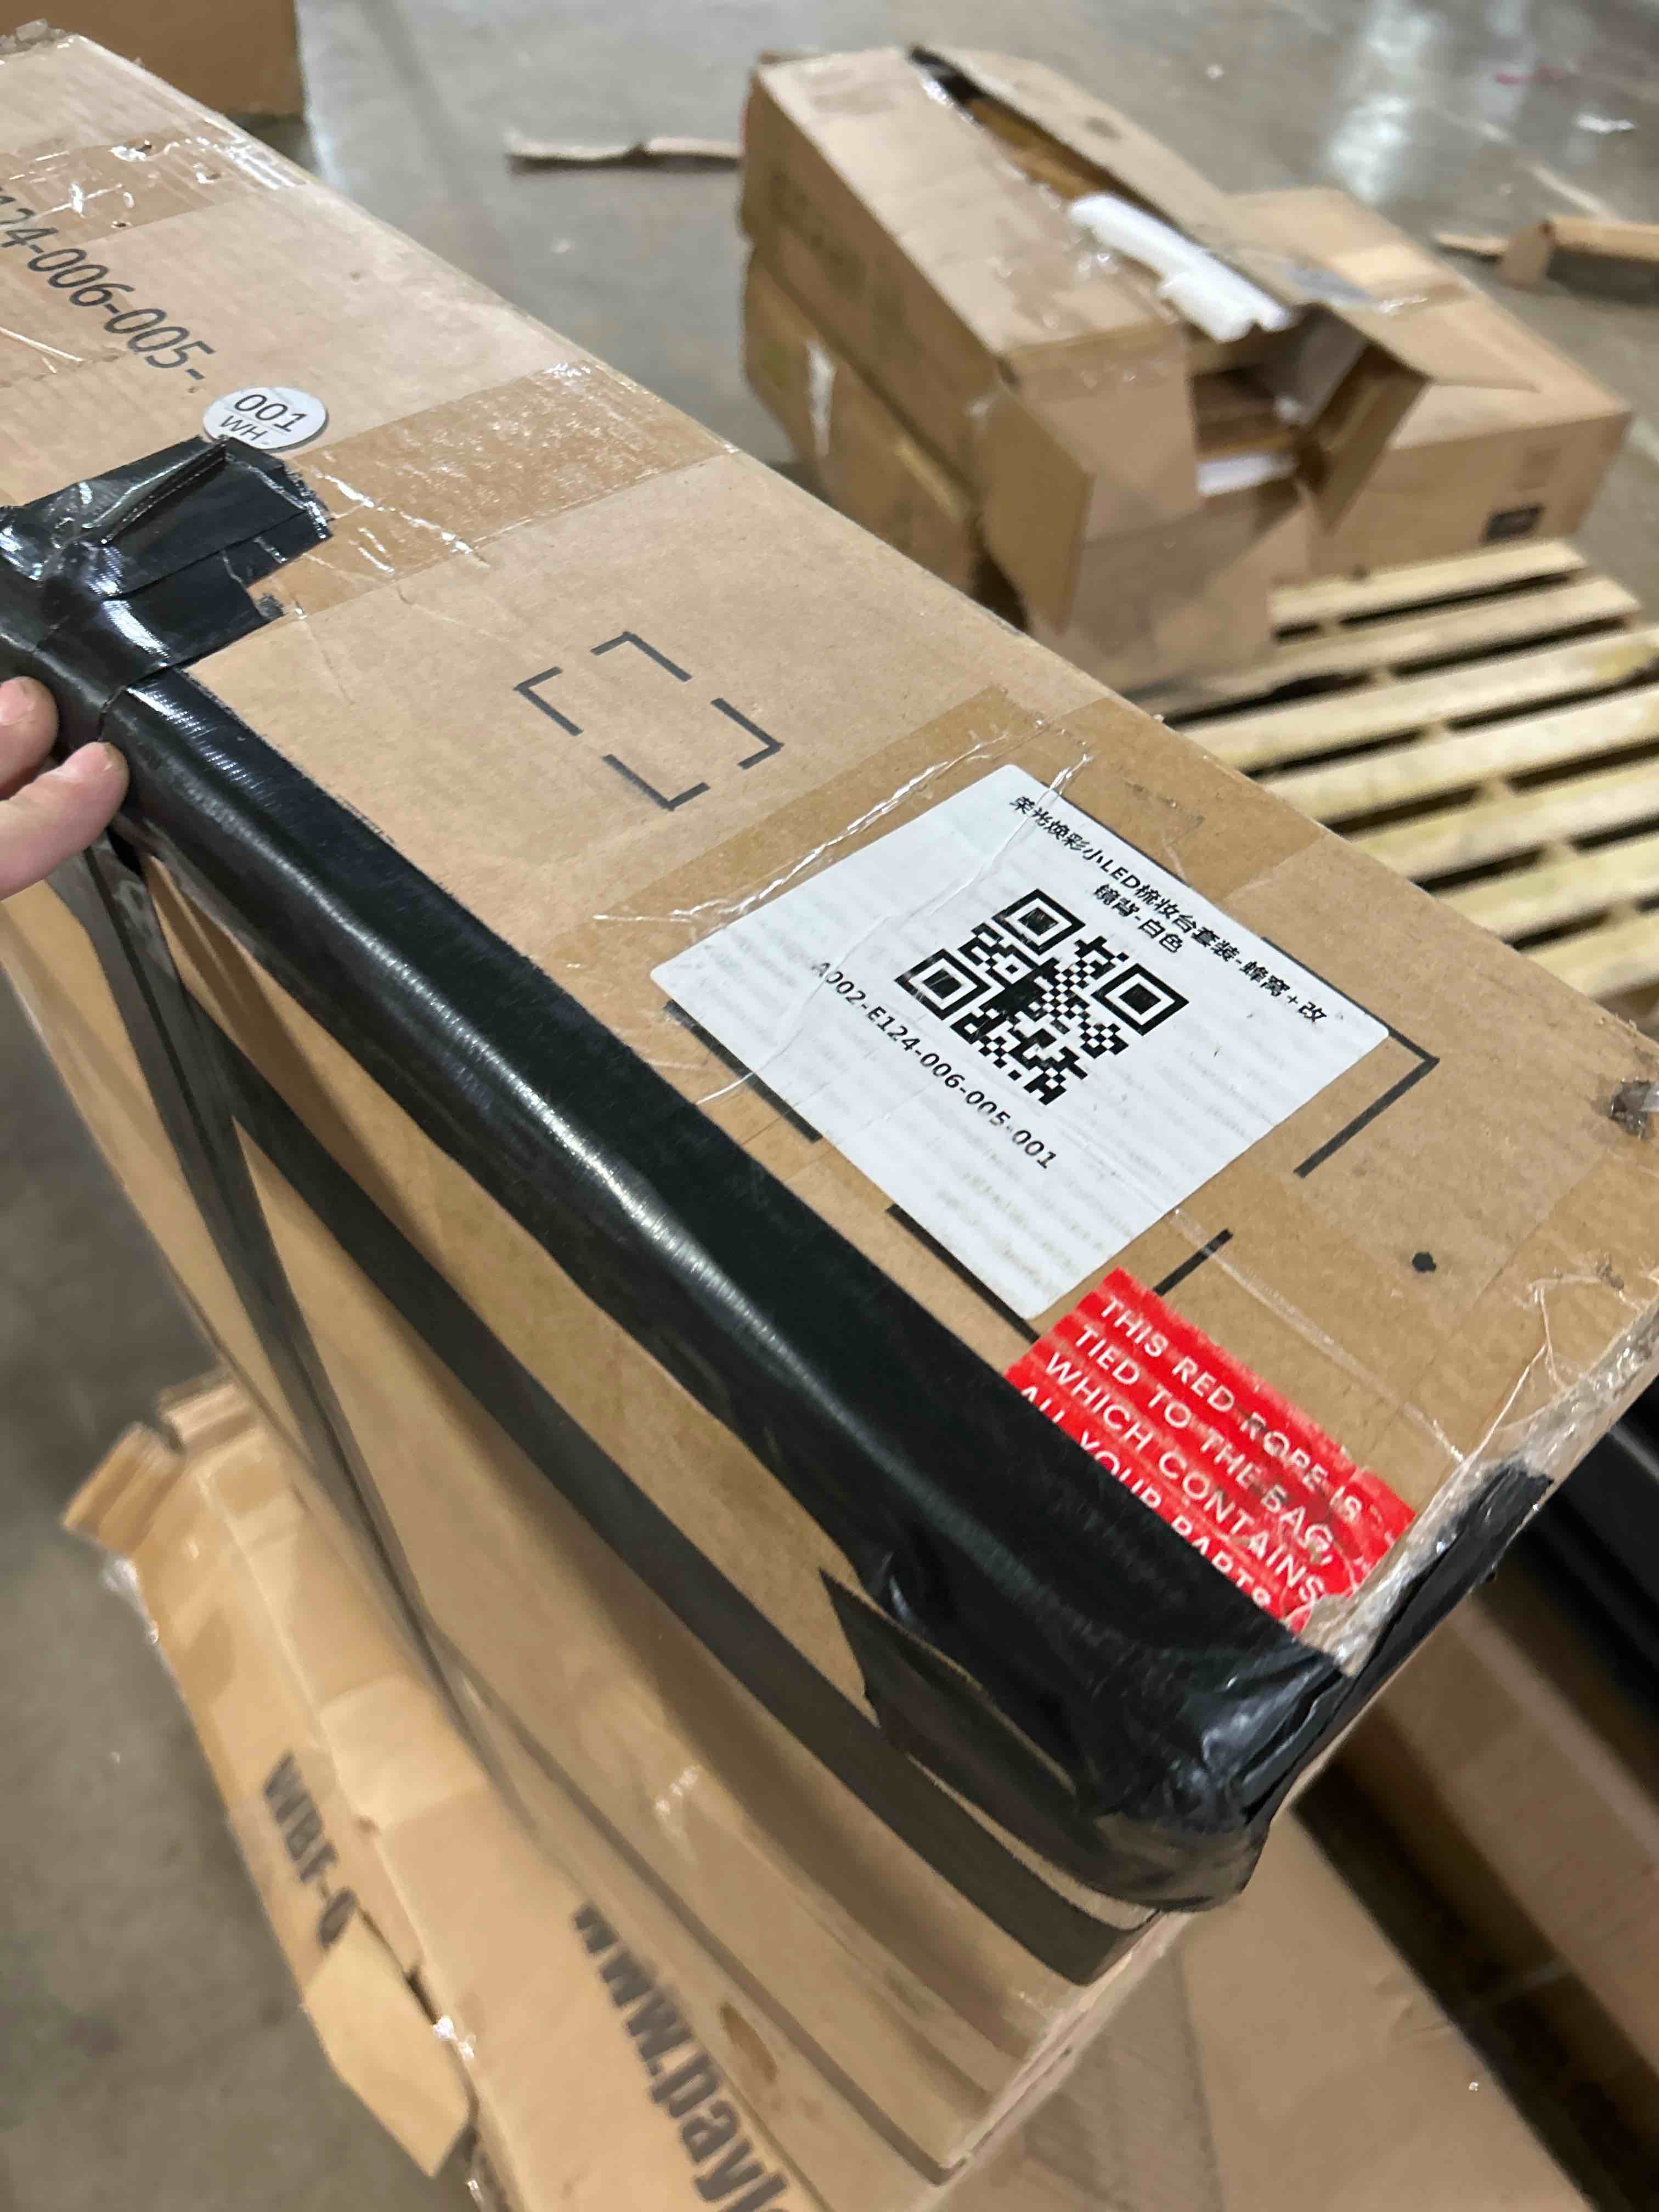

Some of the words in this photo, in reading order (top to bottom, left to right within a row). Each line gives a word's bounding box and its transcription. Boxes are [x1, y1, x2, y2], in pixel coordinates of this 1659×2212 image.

[0, 185, 216, 380] 24-006-005-
[219, 415, 268, 441] WH
[234, 394, 307, 432] 001
[1093, 884, 1183, 953] 镜背-白色
[811, 961, 1057, 1169] A002-E124-006-005-001
[1045, 1352, 1153, 1452] WHICH
[1159, 1452, 1324, 1604] CONTAINS
[1075, 1324, 1139, 1385] TIED
[1148, 1383, 1191, 1429] TO
[1200, 1428, 1263, 1489] THE
[1099, 1296, 1169, 1358] THIS
[1172, 1355, 1235, 1413] RED
[1240, 1413, 1329, 1491] ROPE
[1330, 1486, 1363, 1522] IS
